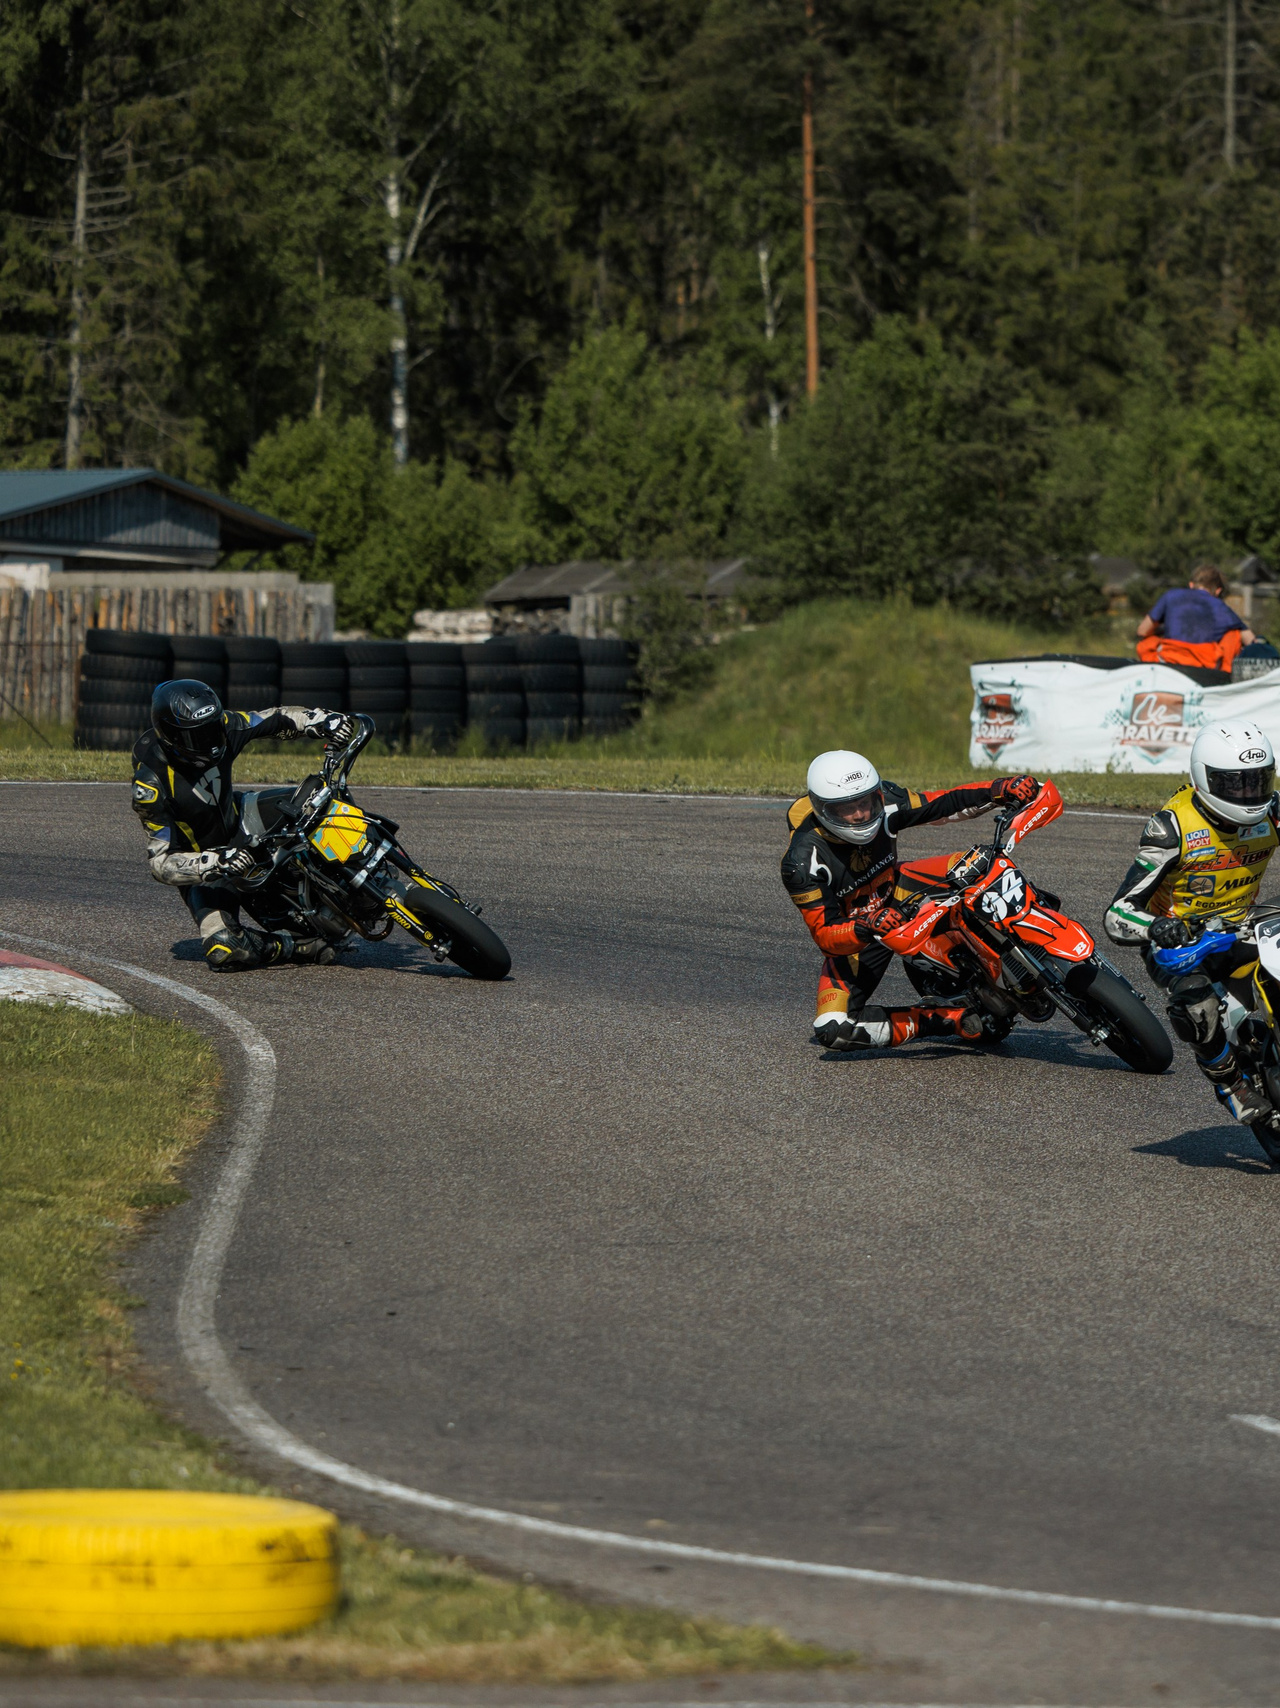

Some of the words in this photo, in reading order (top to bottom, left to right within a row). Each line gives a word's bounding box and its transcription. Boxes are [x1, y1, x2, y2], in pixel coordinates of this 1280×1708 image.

[196, 706, 213, 717] HJC
[1018, 806, 1049, 838] ACERBIS
[1186, 828, 1209, 841] LIQUI
[1187, 837, 1211, 849] MOLY
[1211, 845, 1249, 870] 39
[836, 885, 854, 898] QLA
[913, 909, 944, 938] ACERBIS
